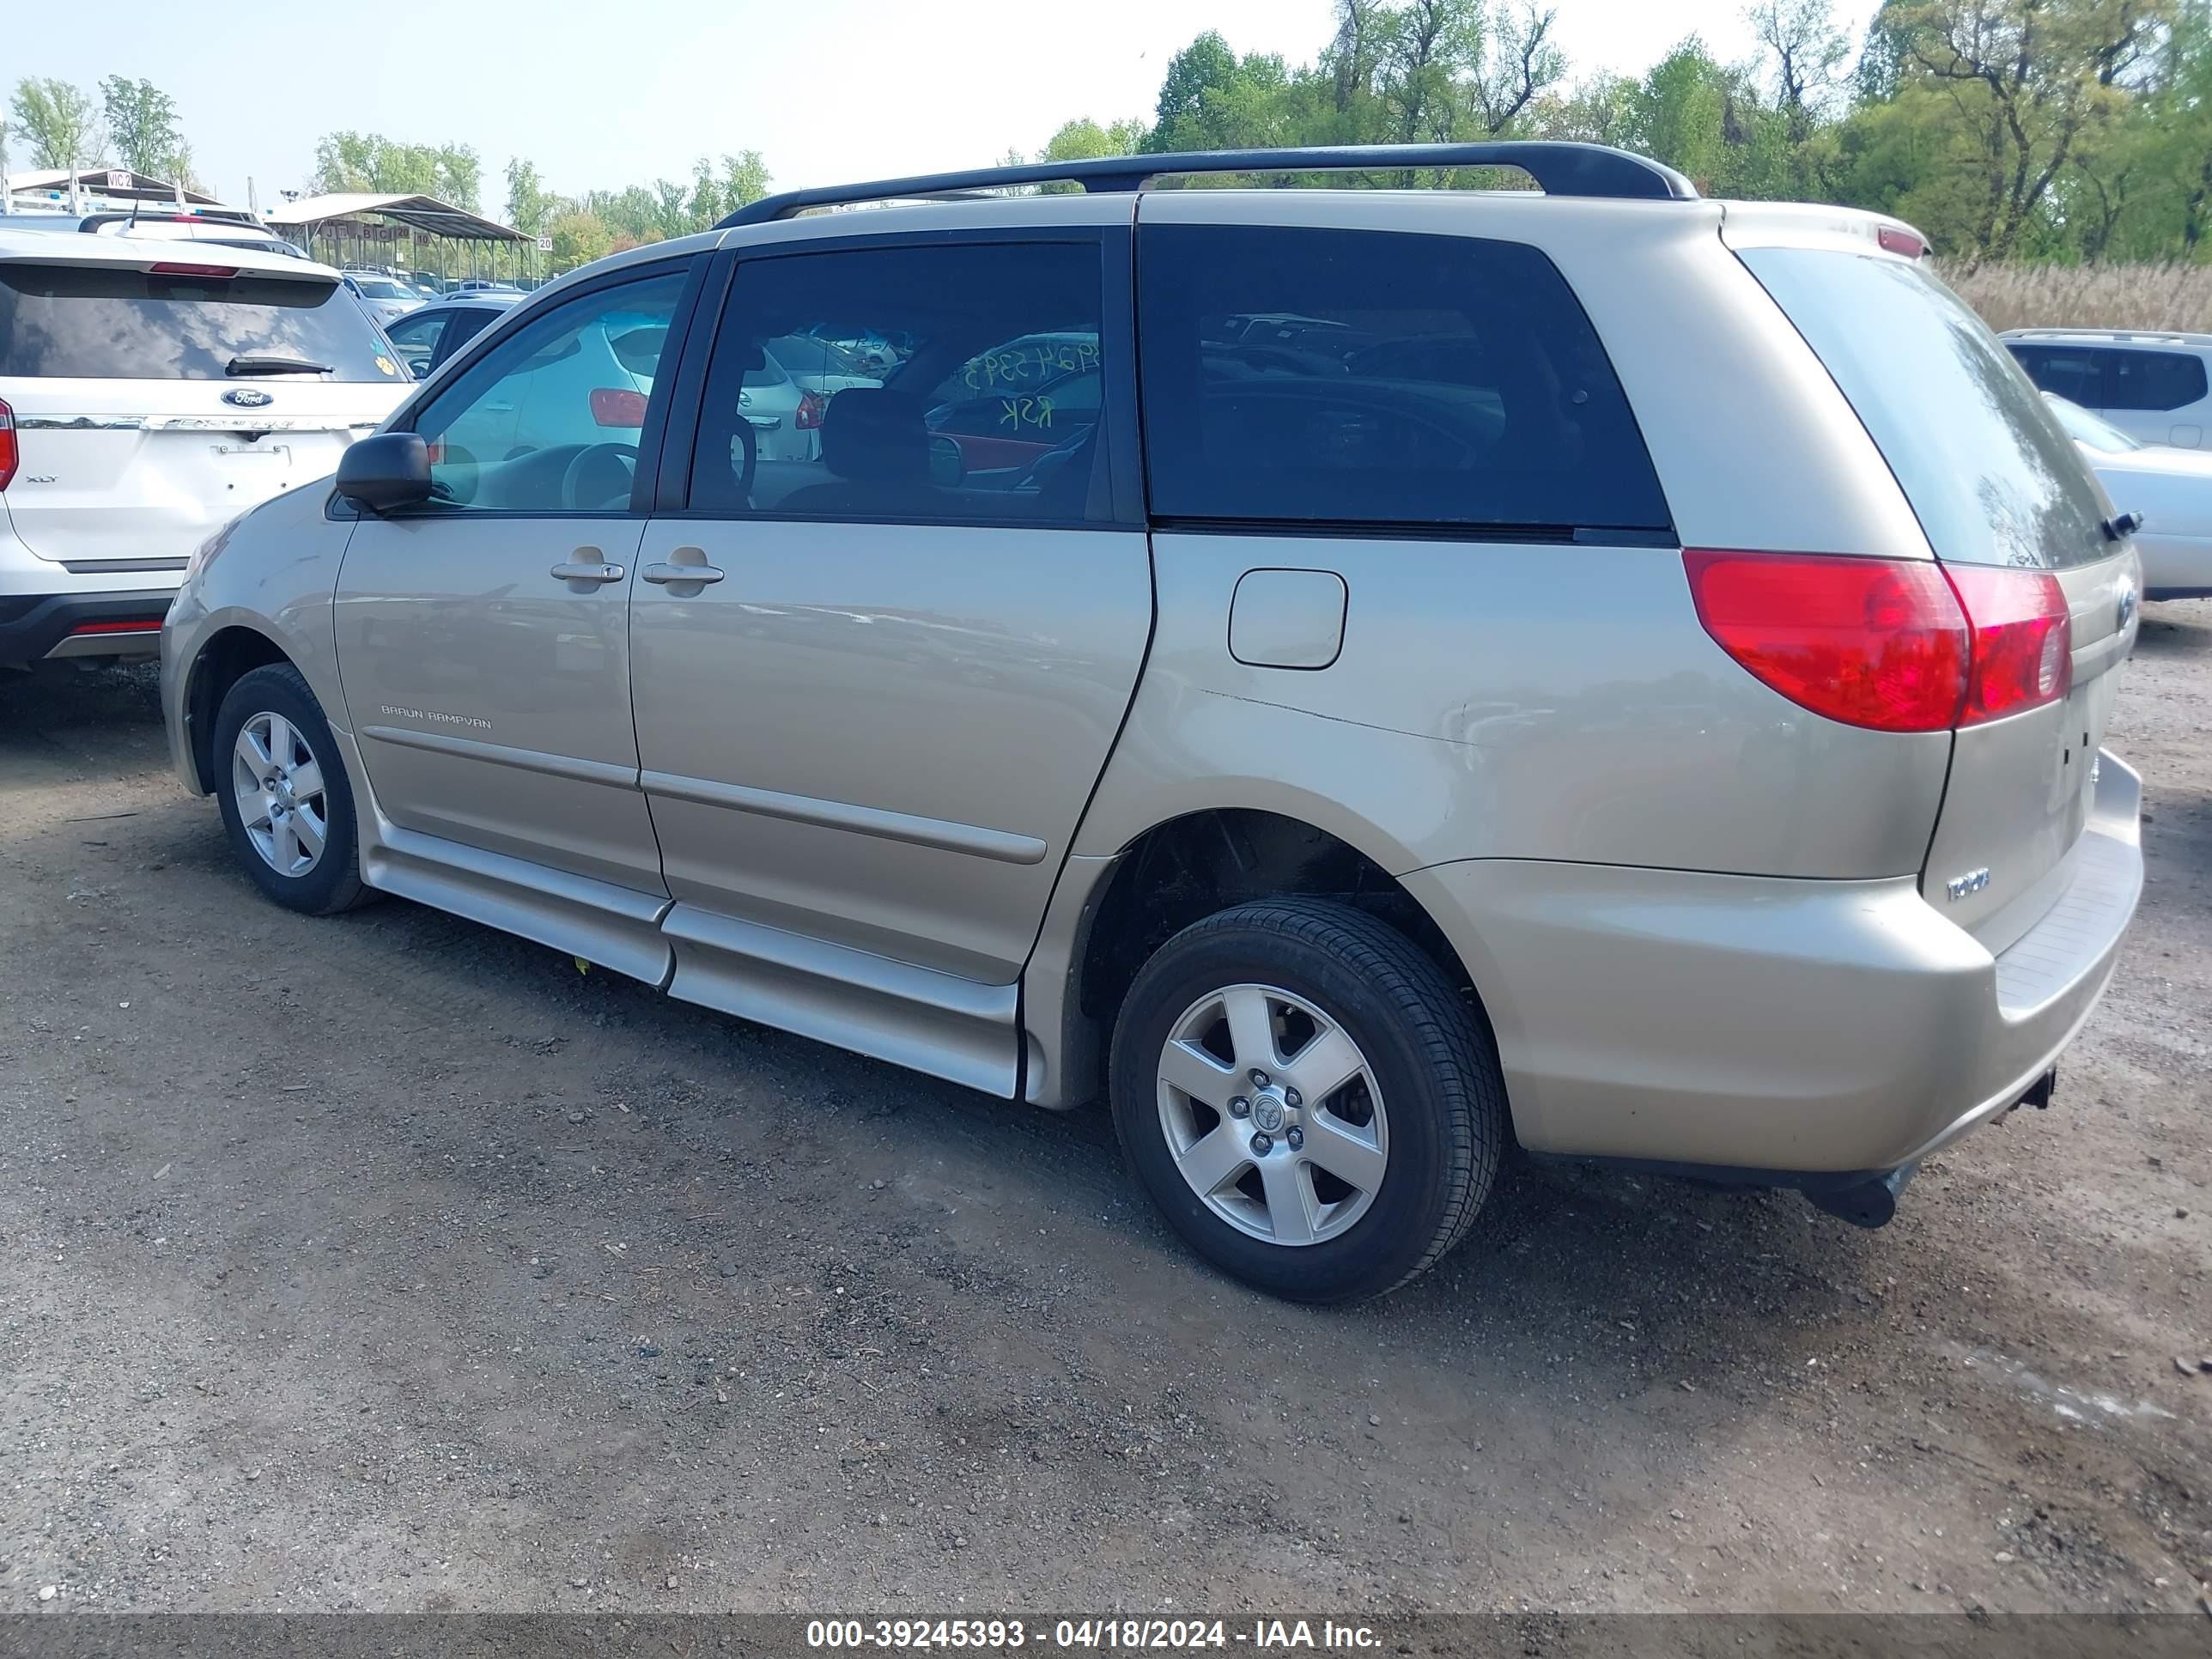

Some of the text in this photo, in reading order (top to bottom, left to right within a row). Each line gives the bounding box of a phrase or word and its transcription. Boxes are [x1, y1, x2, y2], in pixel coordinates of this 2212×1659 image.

[108, 173, 131, 187] VIC 2
[363, 229, 372, 239] B
[398, 228, 409, 237] 20
[418, 234, 428, 244] 10
[540, 240, 551, 248] 20
[234, 390, 264, 404] Ford
[381, 705, 492, 729] BRAUN RAMPVAN
